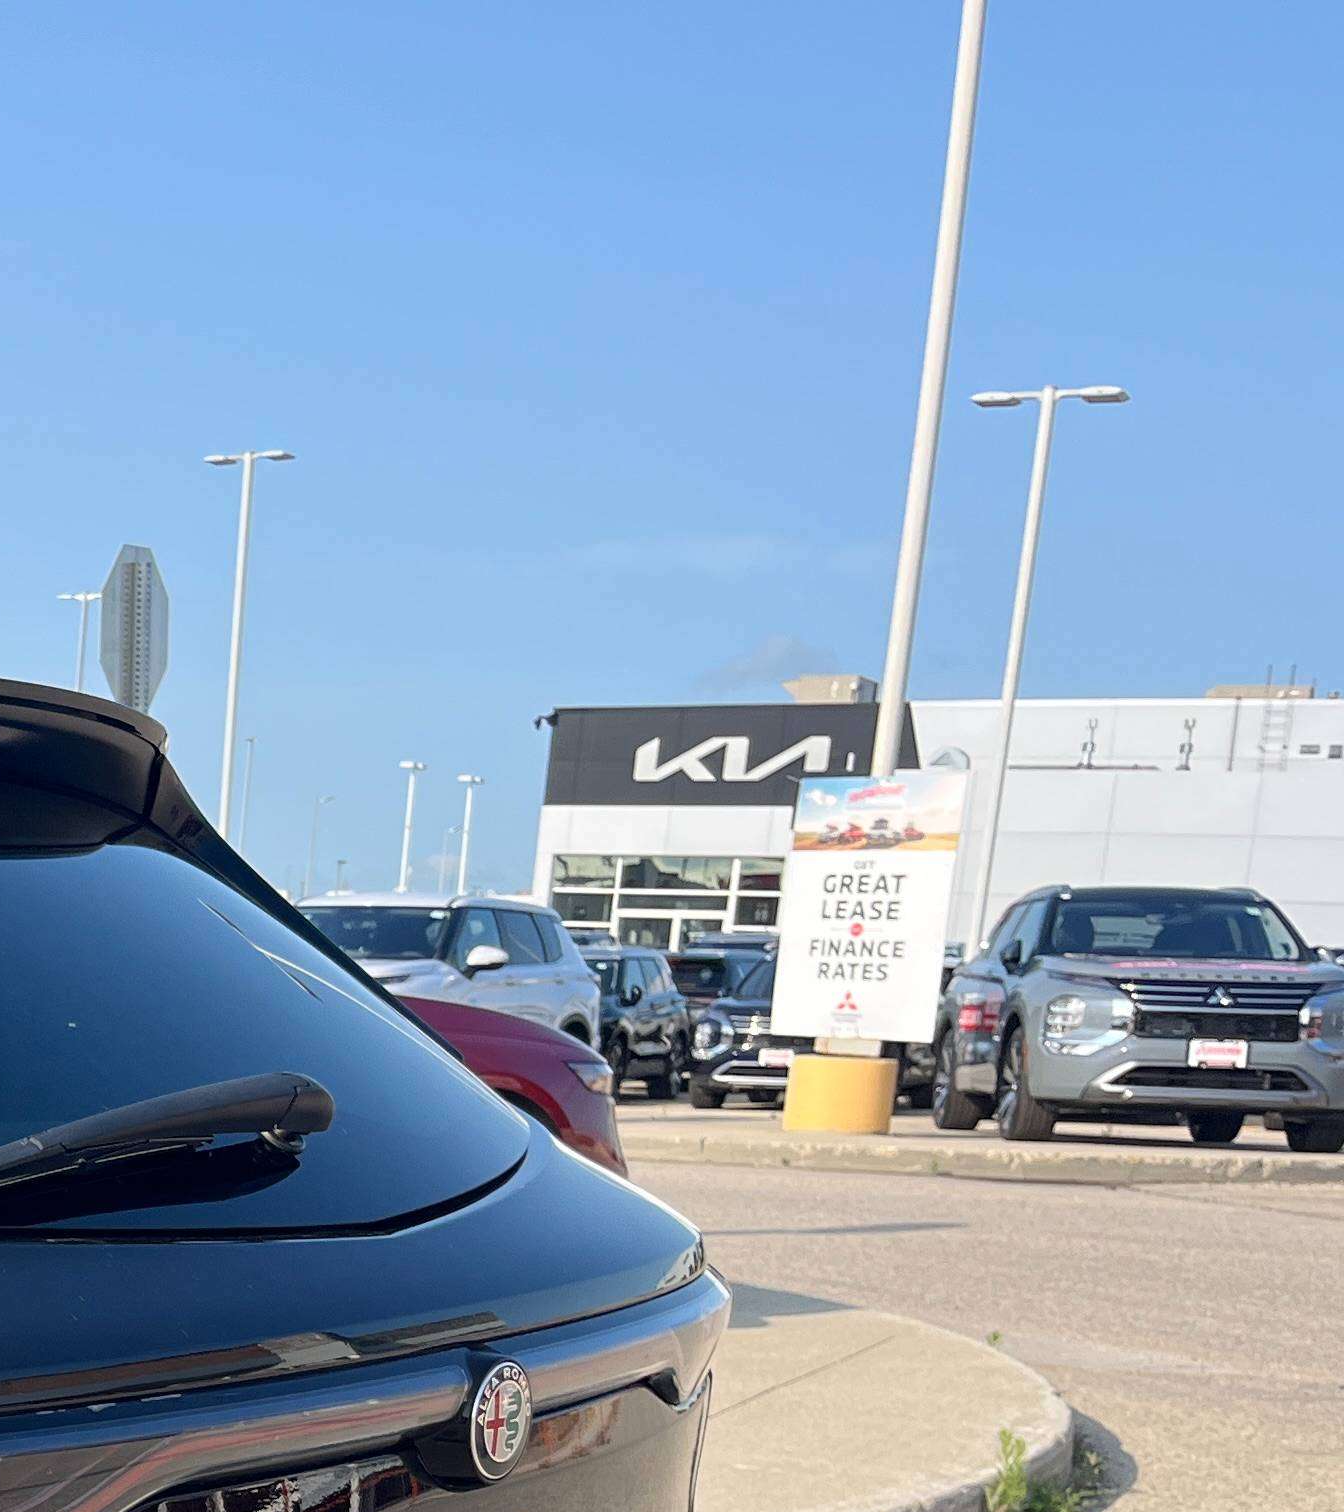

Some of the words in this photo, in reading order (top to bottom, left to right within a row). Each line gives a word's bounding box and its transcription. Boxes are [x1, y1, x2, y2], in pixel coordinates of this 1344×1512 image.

[633, 735, 832, 782] KIA
[823, 874, 907, 894] GREAT
[821, 900, 902, 920] LEASE
[809, 939, 906, 958] FINANCE
[817, 962, 889, 981] RATES
[476, 1376, 500, 1427] ALFA
